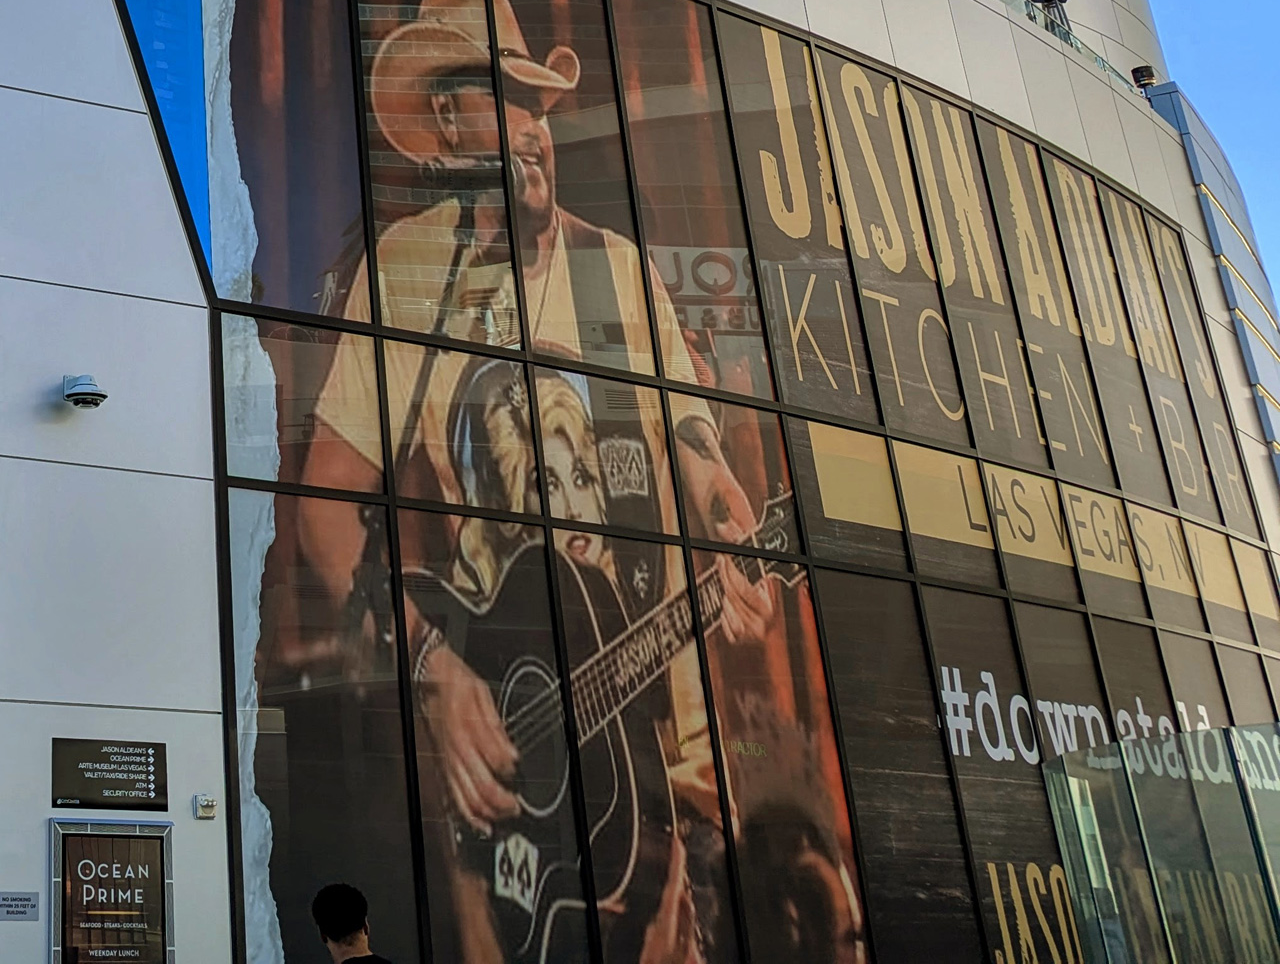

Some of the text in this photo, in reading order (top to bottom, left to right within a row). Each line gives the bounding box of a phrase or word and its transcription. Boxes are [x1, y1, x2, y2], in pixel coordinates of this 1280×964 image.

[759, 24, 1216, 400] JASON ALDEAN'S
[778, 263, 1253, 521] KITCHEN + BAR
[957, 464, 1037, 544] LAS
[1164, 521, 1207, 588] NV
[102, 789, 148, 798] SECURITY OFFICE
[77, 859, 149, 881] OCEAN
[83, 884, 144, 906] PRIME
